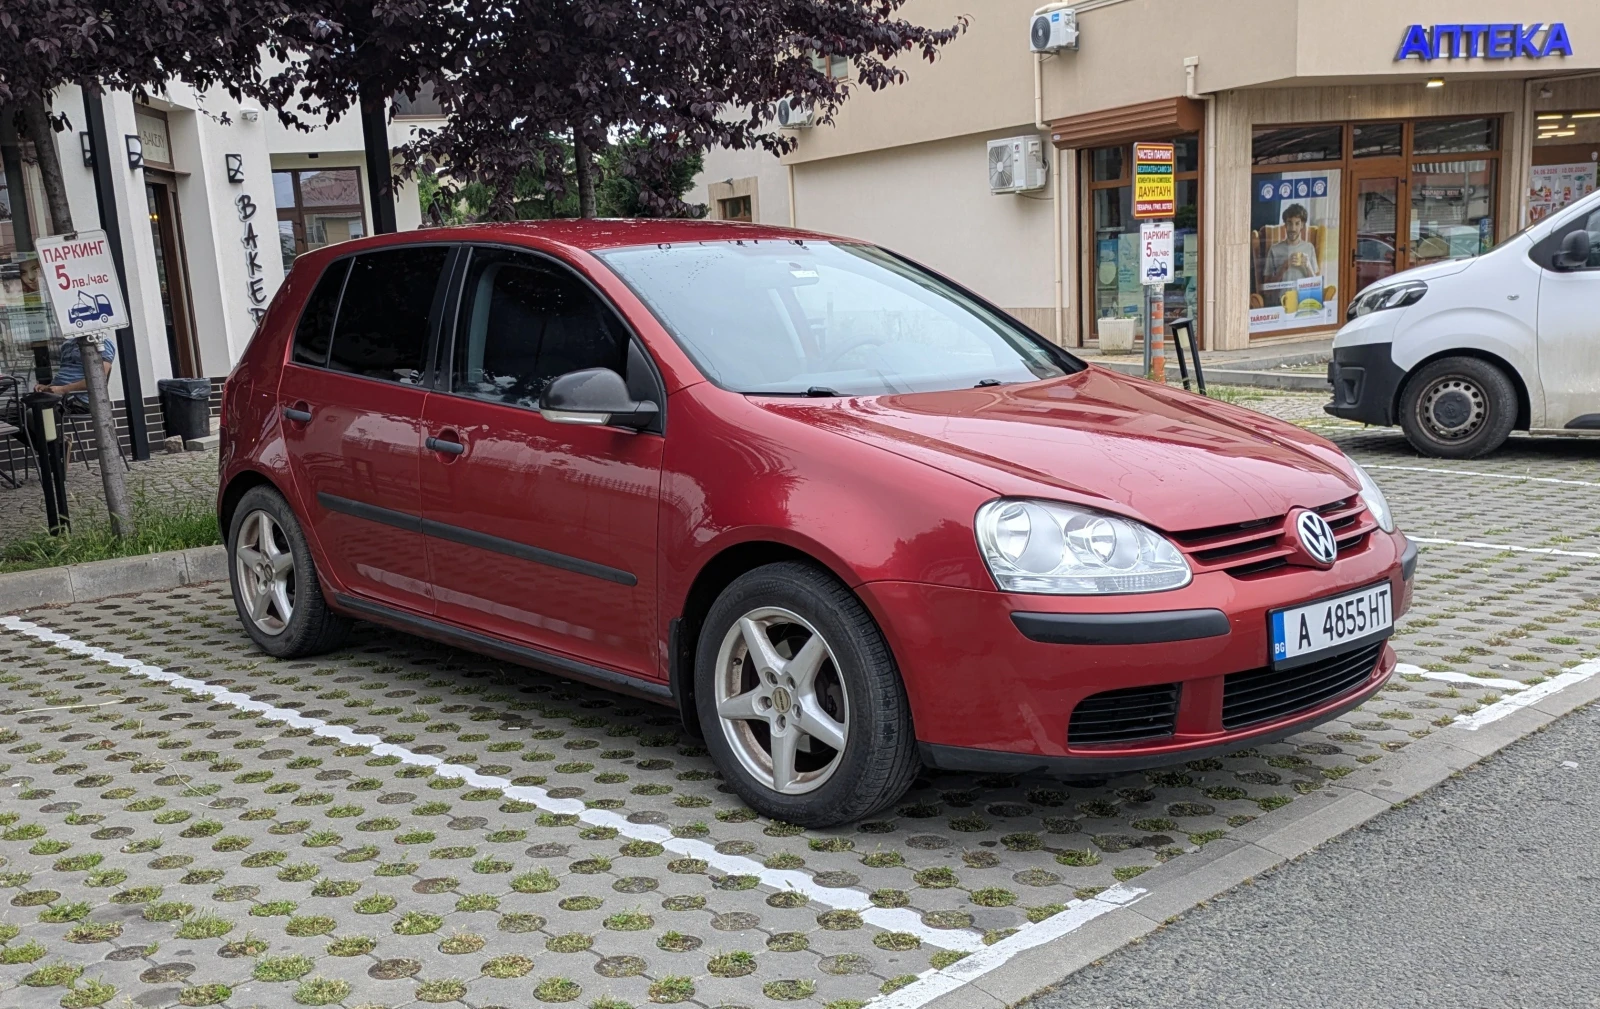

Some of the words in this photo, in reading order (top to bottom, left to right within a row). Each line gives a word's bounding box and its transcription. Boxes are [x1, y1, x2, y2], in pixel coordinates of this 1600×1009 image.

[1397, 22, 1573, 61] АПТЕКА
[1137, 149, 1153, 160] ЧАСТЕН
[1154, 149, 1172, 160] ПАРКИНГ
[1138, 185, 1172, 199] ДАУНТАУН
[1143, 230, 1172, 241] ПАРКИНГ
[42, 240, 105, 264] ПАРКИНГ
[1297, 612, 1312, 650] A
[1274, 641, 1286, 655] BG
